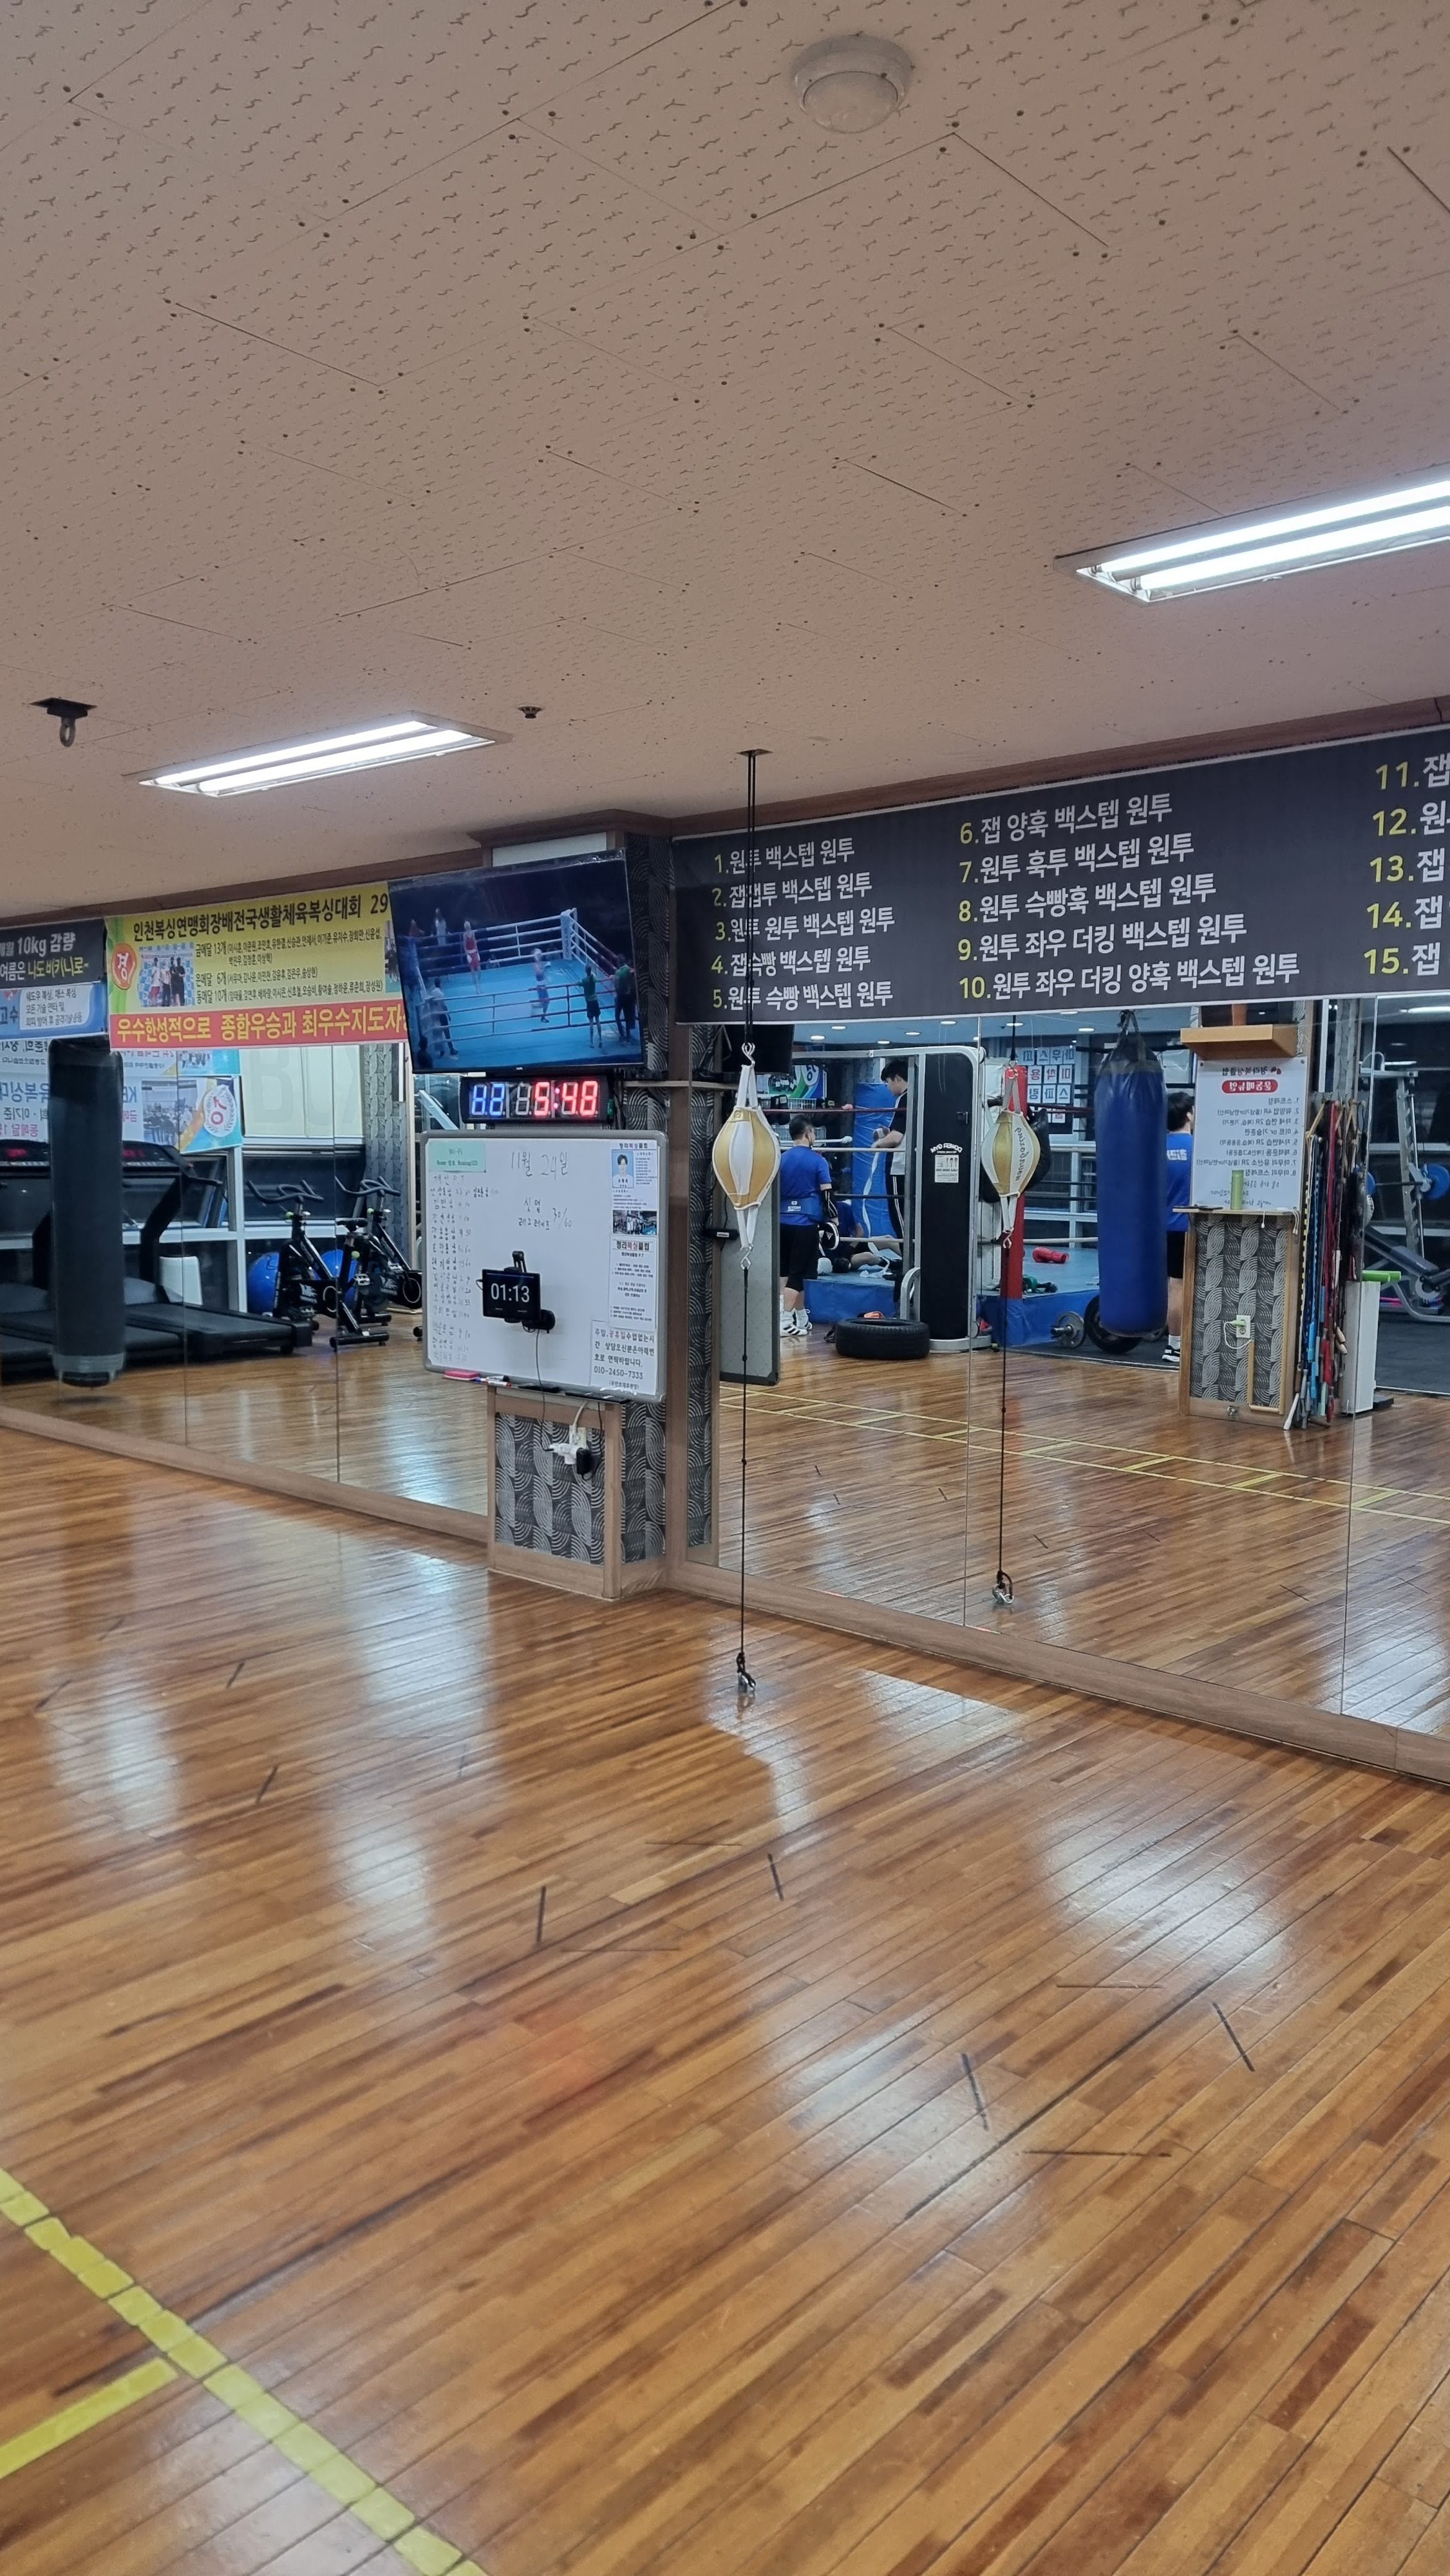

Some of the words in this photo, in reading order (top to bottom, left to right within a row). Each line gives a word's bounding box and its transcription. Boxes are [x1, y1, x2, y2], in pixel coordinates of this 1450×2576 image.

[1007, 809, 1049, 842] 양훅
[1055, 799, 1119, 834] 백스텝
[1126, 793, 1172, 827] 원투
[766, 841, 814, 870] 백스텝
[820, 837, 855, 866] 원투
[1026, 848, 1068, 879] 훅투
[1075, 838, 1140, 873] 백스텝
[1147, 832, 1194, 866] 원투
[782, 875, 831, 904] 백스텝
[836, 871, 872, 899] 원투
[1095, 876, 1162, 911] 백스텝
[1169, 873, 1216, 905] 원투
[764, 915, 800, 941] 원투
[803, 909, 854, 938] 백스텝
[859, 906, 895, 934] 원투
[1024, 929, 1067, 959] 좌우
[1073, 923, 1115, 954] 더킹
[1122, 917, 1191, 951] 백스텝
[1197, 913, 1247, 946] 원투
[17, 936, 47, 958] 10kg
[50, 931, 76, 952] 감량
[780, 947, 831, 976] 백스텝
[836, 945, 871, 972] 원투
[0, 961, 26, 981] 여름은
[1035, 969, 1076, 998] 좌우
[1081, 965, 1121, 995] 더킹
[1129, 961, 1171, 993] 양훅
[1177, 956, 1245, 989] 백스텝
[1252, 952, 1300, 986] 원투
[803, 983, 852, 1009] 백스텝
[857, 981, 893, 1007] 원투
[116, 1016, 211, 1043] 우수한성적으로
[220, 1008, 297, 1041] 종합우승과
[302, 1003, 408, 1038] 최우수지도자
[491, 1282, 530, 1303] 01:13
[593, 1365, 643, 1379] 010-2450-7333
